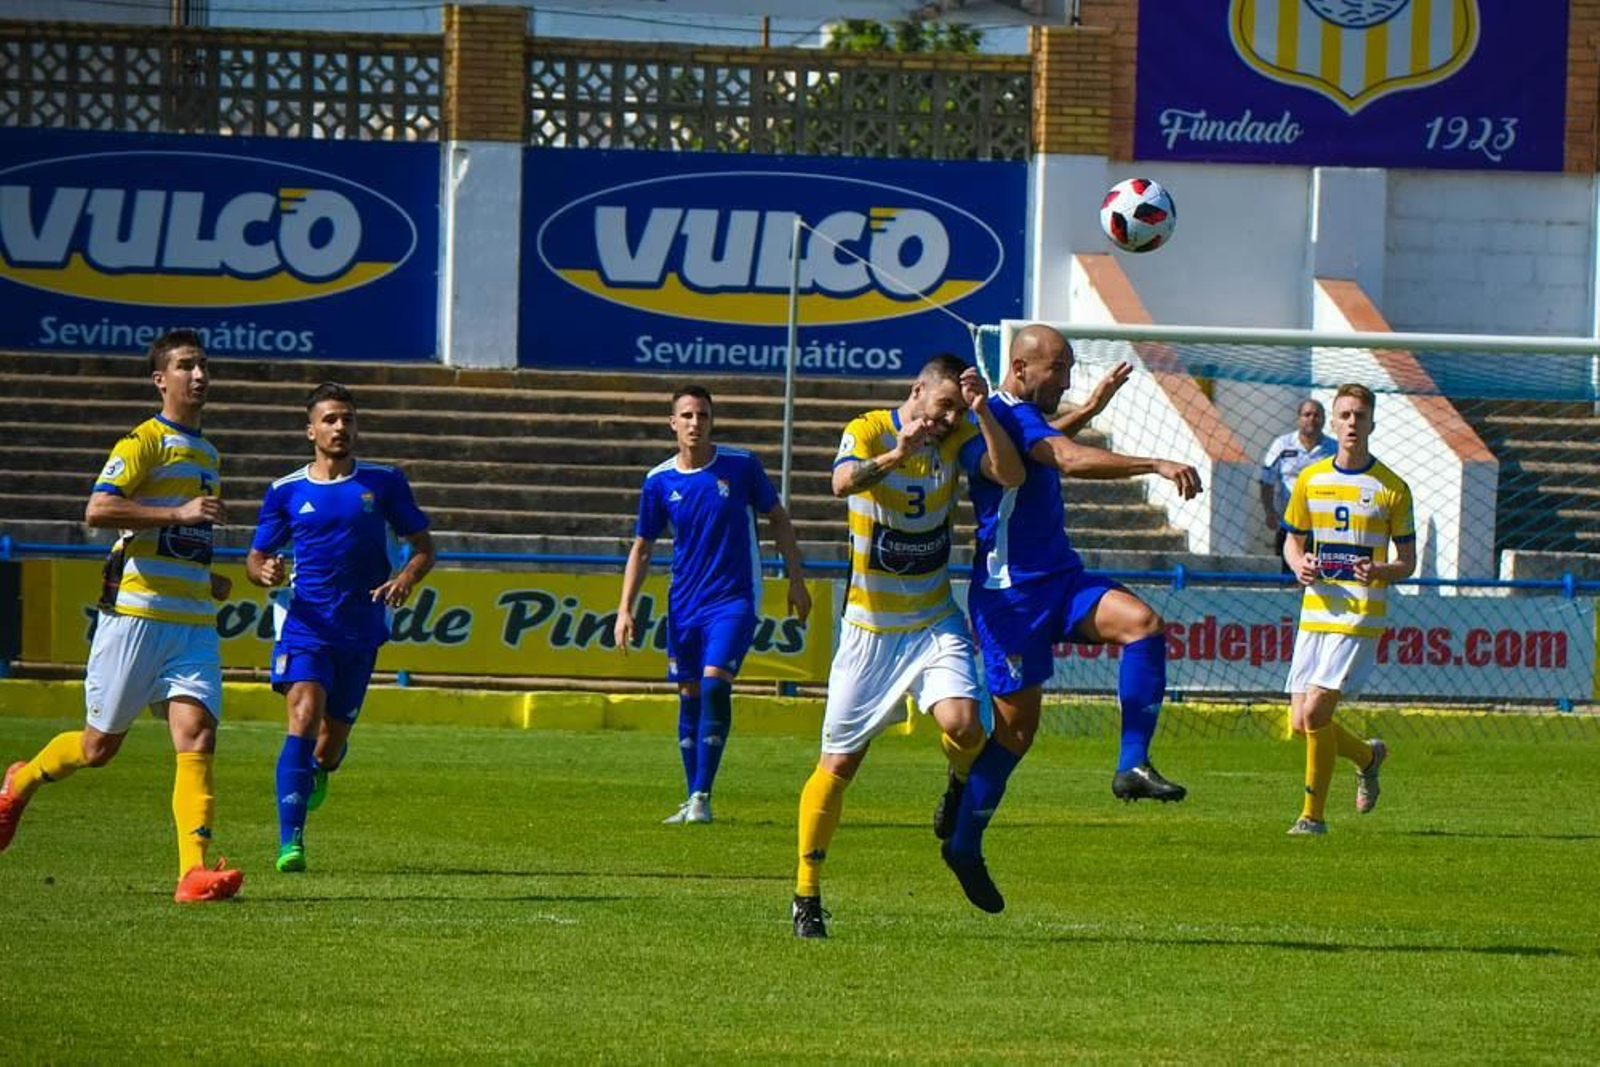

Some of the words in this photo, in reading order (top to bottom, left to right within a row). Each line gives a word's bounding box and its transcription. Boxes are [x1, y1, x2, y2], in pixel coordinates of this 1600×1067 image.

[1159, 109, 1304, 150] Fundado
[1426, 116, 1519, 162] 1923
[0, 186, 362, 279] VULCO
[595, 206, 950, 295] VULCO
[39, 316, 314, 353] Sevineáticos
[635, 334, 903, 371] Sevineumáticos
[904, 485, 926, 520] 3
[1335, 506, 1350, 532] 9
[389, 587, 472, 643] de
[498, 589, 808, 654] Pintas
